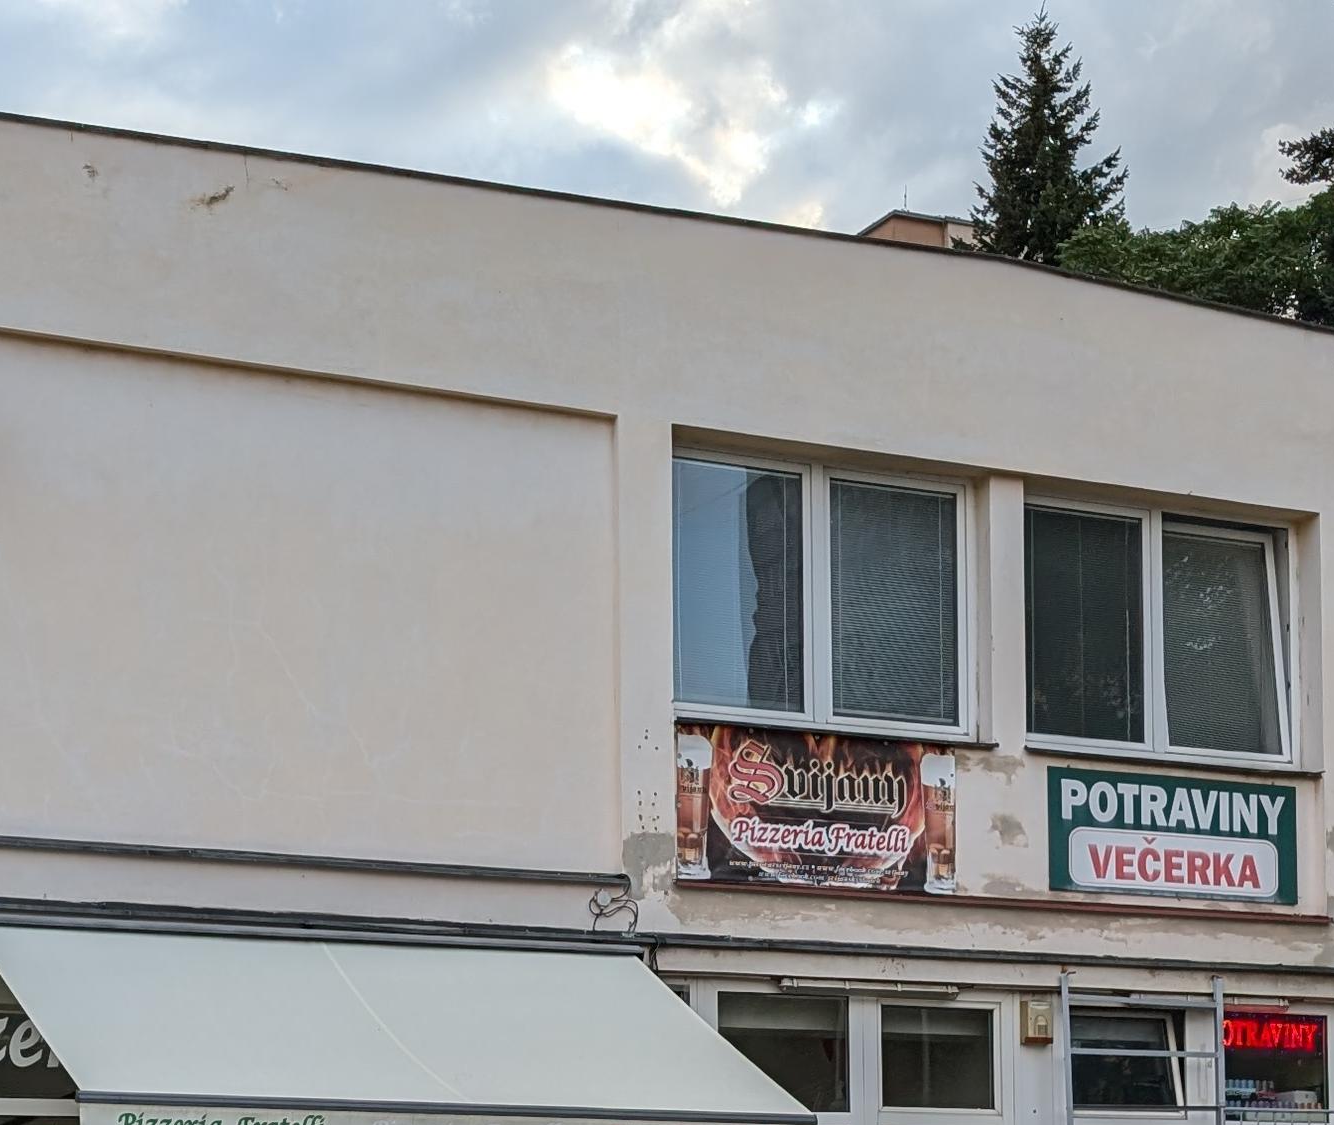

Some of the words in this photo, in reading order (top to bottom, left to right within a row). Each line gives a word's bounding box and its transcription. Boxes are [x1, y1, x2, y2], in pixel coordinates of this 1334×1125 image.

[727, 740, 907, 819] Svijany
[1061, 778, 1285, 835] POTRAVINY
[732, 818, 824, 850] Pizzeria
[828, 824, 911, 854] Fratelli
[1088, 837, 1261, 889] VEČERKA
[1223, 1020, 1319, 1051] OTRAVINY
